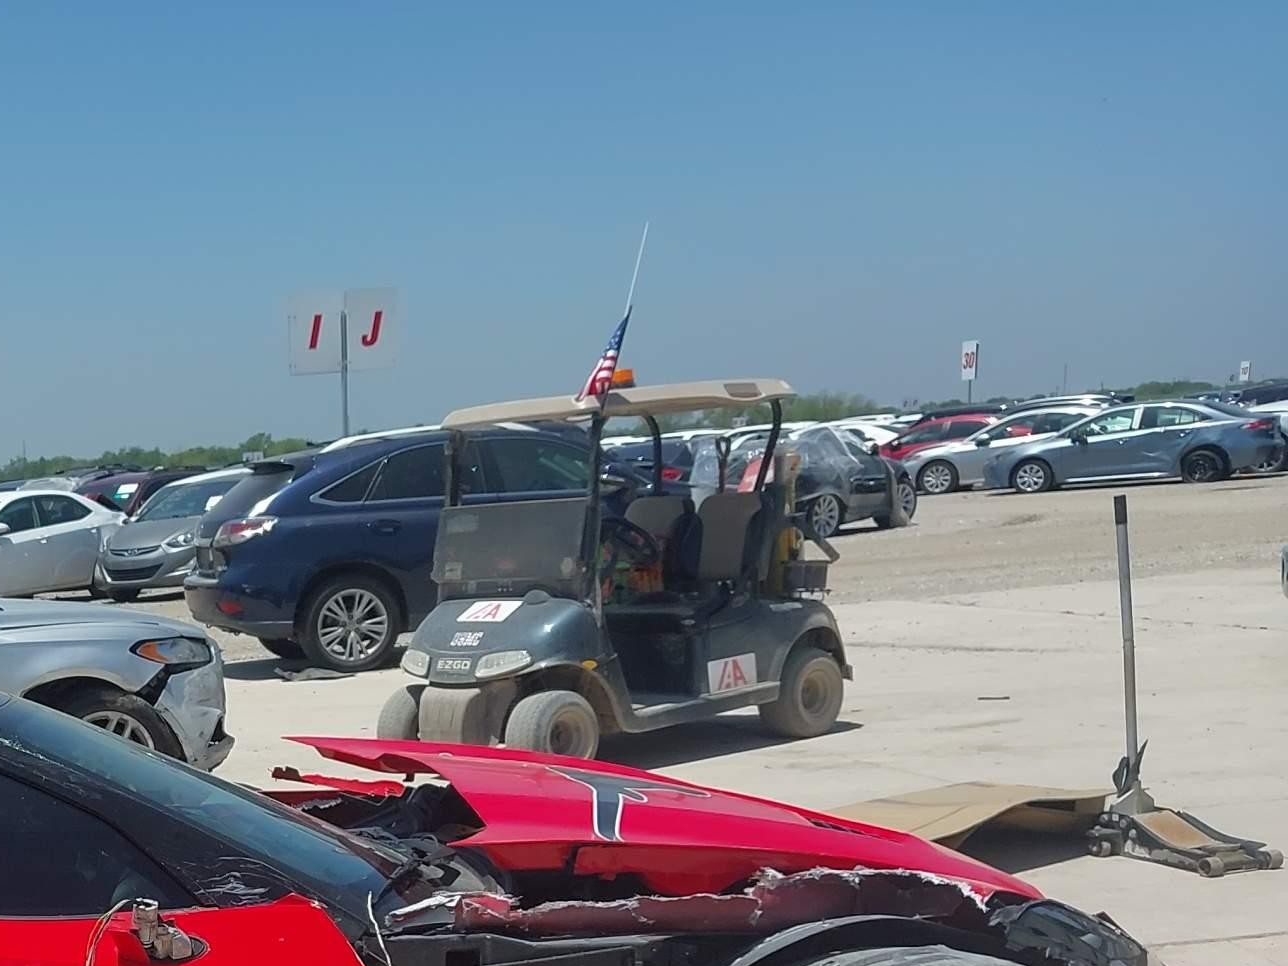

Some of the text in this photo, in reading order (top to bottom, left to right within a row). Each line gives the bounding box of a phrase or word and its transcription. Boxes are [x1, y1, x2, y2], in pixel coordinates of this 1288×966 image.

[308, 313, 323, 350] I
[361, 310, 383, 347] J
[962, 351, 976, 370] 30
